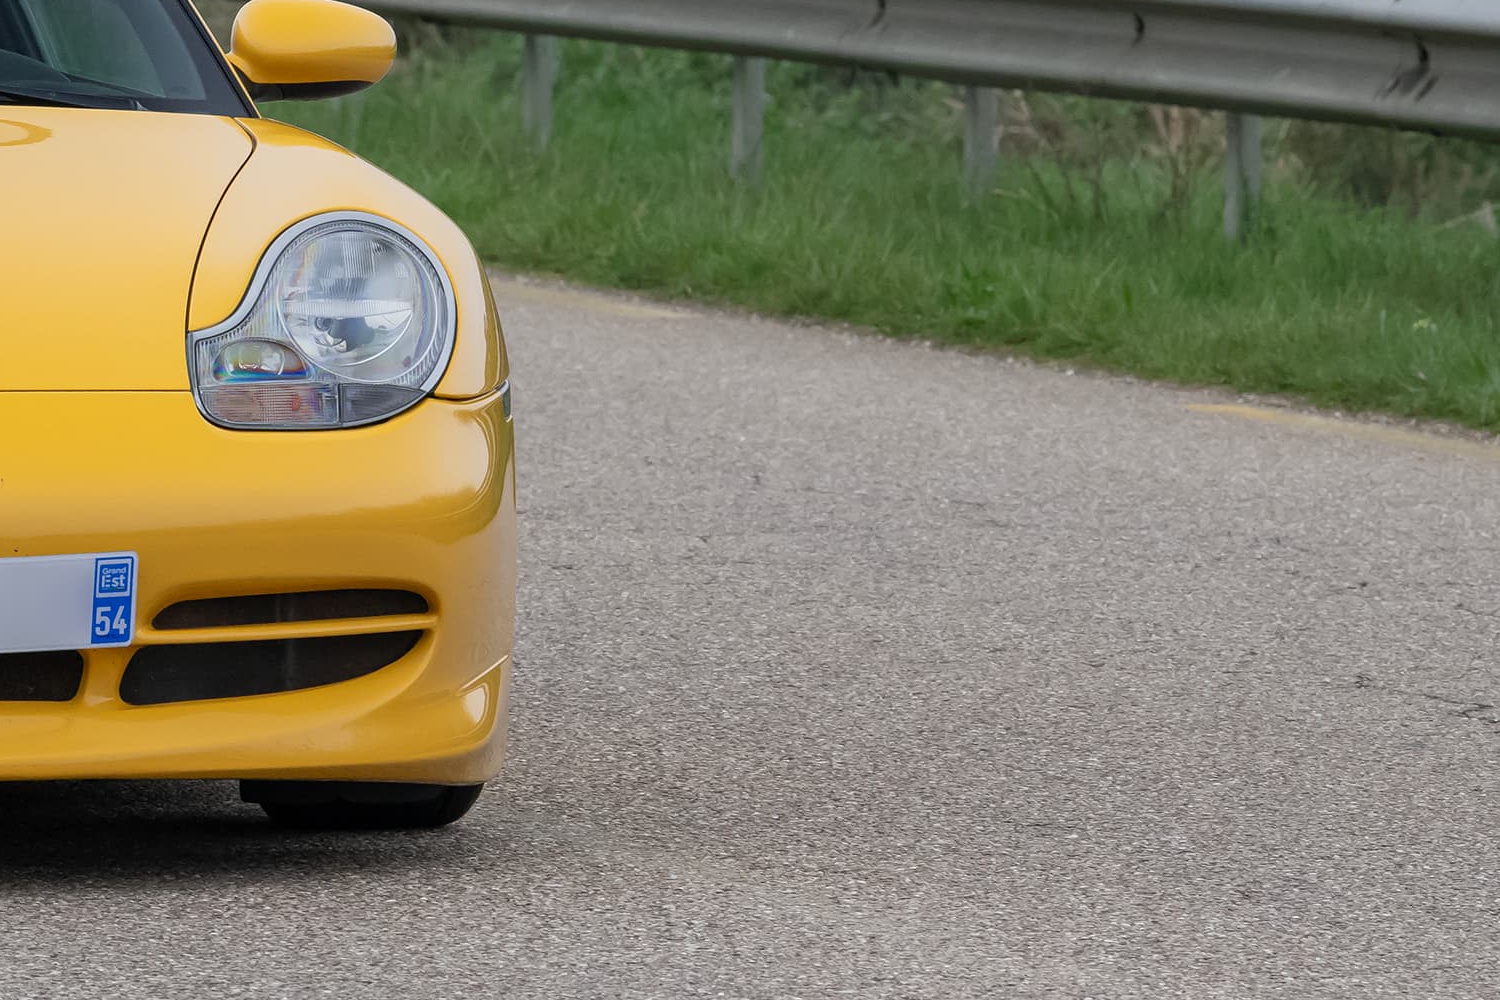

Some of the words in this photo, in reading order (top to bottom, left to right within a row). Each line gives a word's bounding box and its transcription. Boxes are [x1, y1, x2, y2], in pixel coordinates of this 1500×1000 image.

[102, 567, 127, 575] Grand
[101, 574, 126, 588] Est
[95, 605, 128, 636] 54
